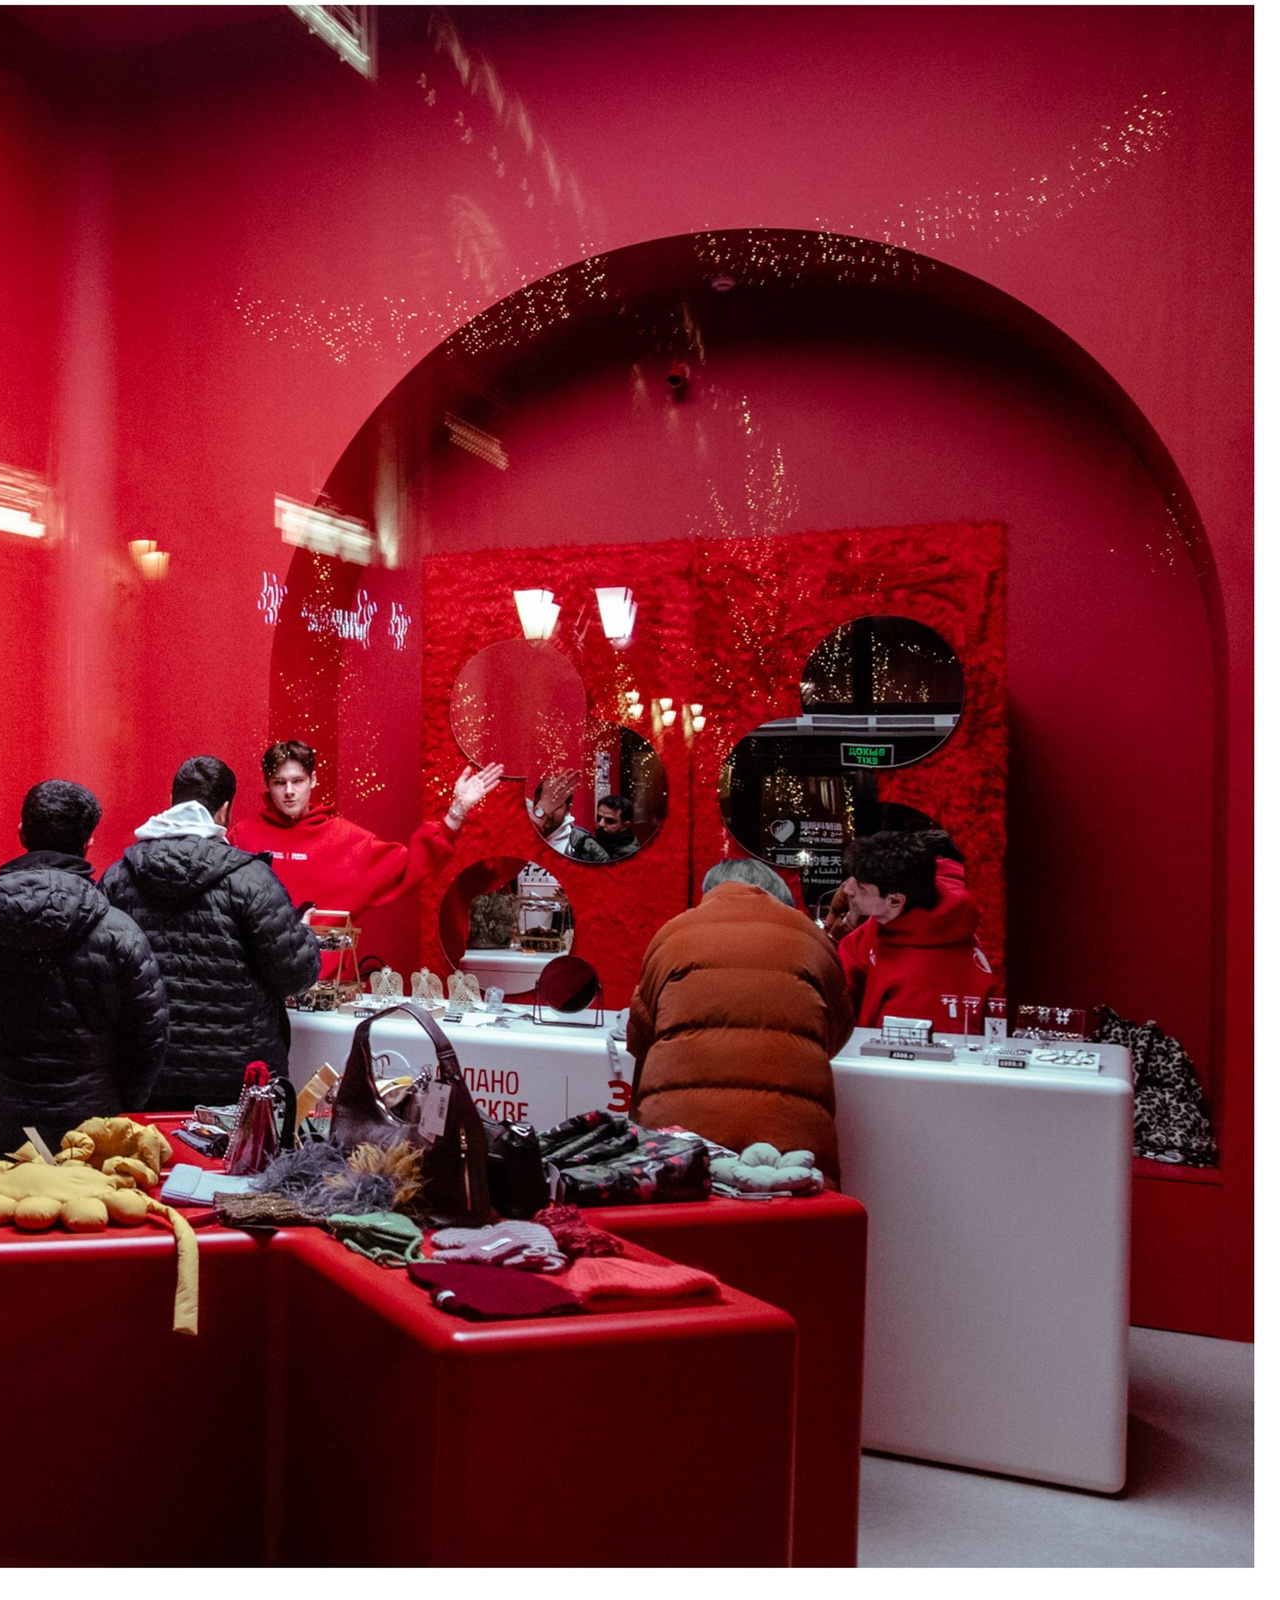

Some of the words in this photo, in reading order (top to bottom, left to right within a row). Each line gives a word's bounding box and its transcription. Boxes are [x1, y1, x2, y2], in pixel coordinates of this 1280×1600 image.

[776, 854, 842, 867] 莫斯的冬天
